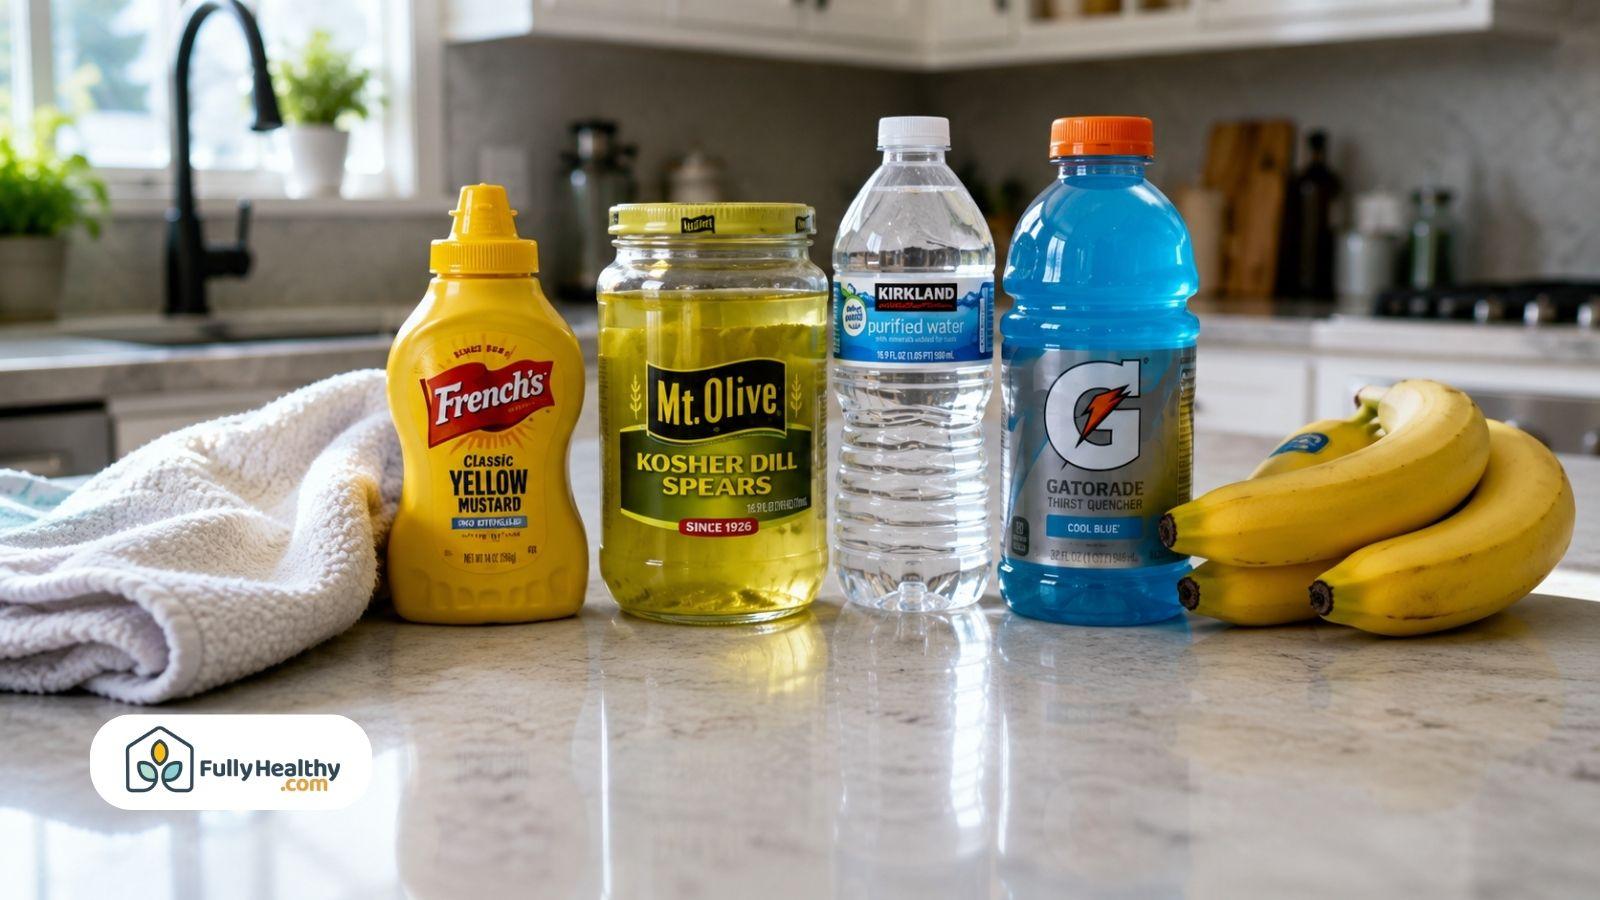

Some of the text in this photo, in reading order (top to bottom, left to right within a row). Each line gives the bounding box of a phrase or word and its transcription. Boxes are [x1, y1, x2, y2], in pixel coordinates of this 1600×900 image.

[879, 286, 954, 300] KIRKLAND
[868, 318, 964, 336] purified water
[434, 369, 545, 427] French's
[657, 376, 778, 426] Mt. Olive
[636, 452, 798, 474] KOSHER DILL
[449, 469, 529, 496] YELLOW
[662, 476, 773, 497] SPEARS
[1046, 479, 1144, 496] GATORADE
[458, 497, 521, 514] MUSTARD
[1048, 496, 1143, 511] THIRST QUENCHER
[685, 521, 752, 534] SINCE 1926
[1067, 523, 1120, 533] COOL BLUE
